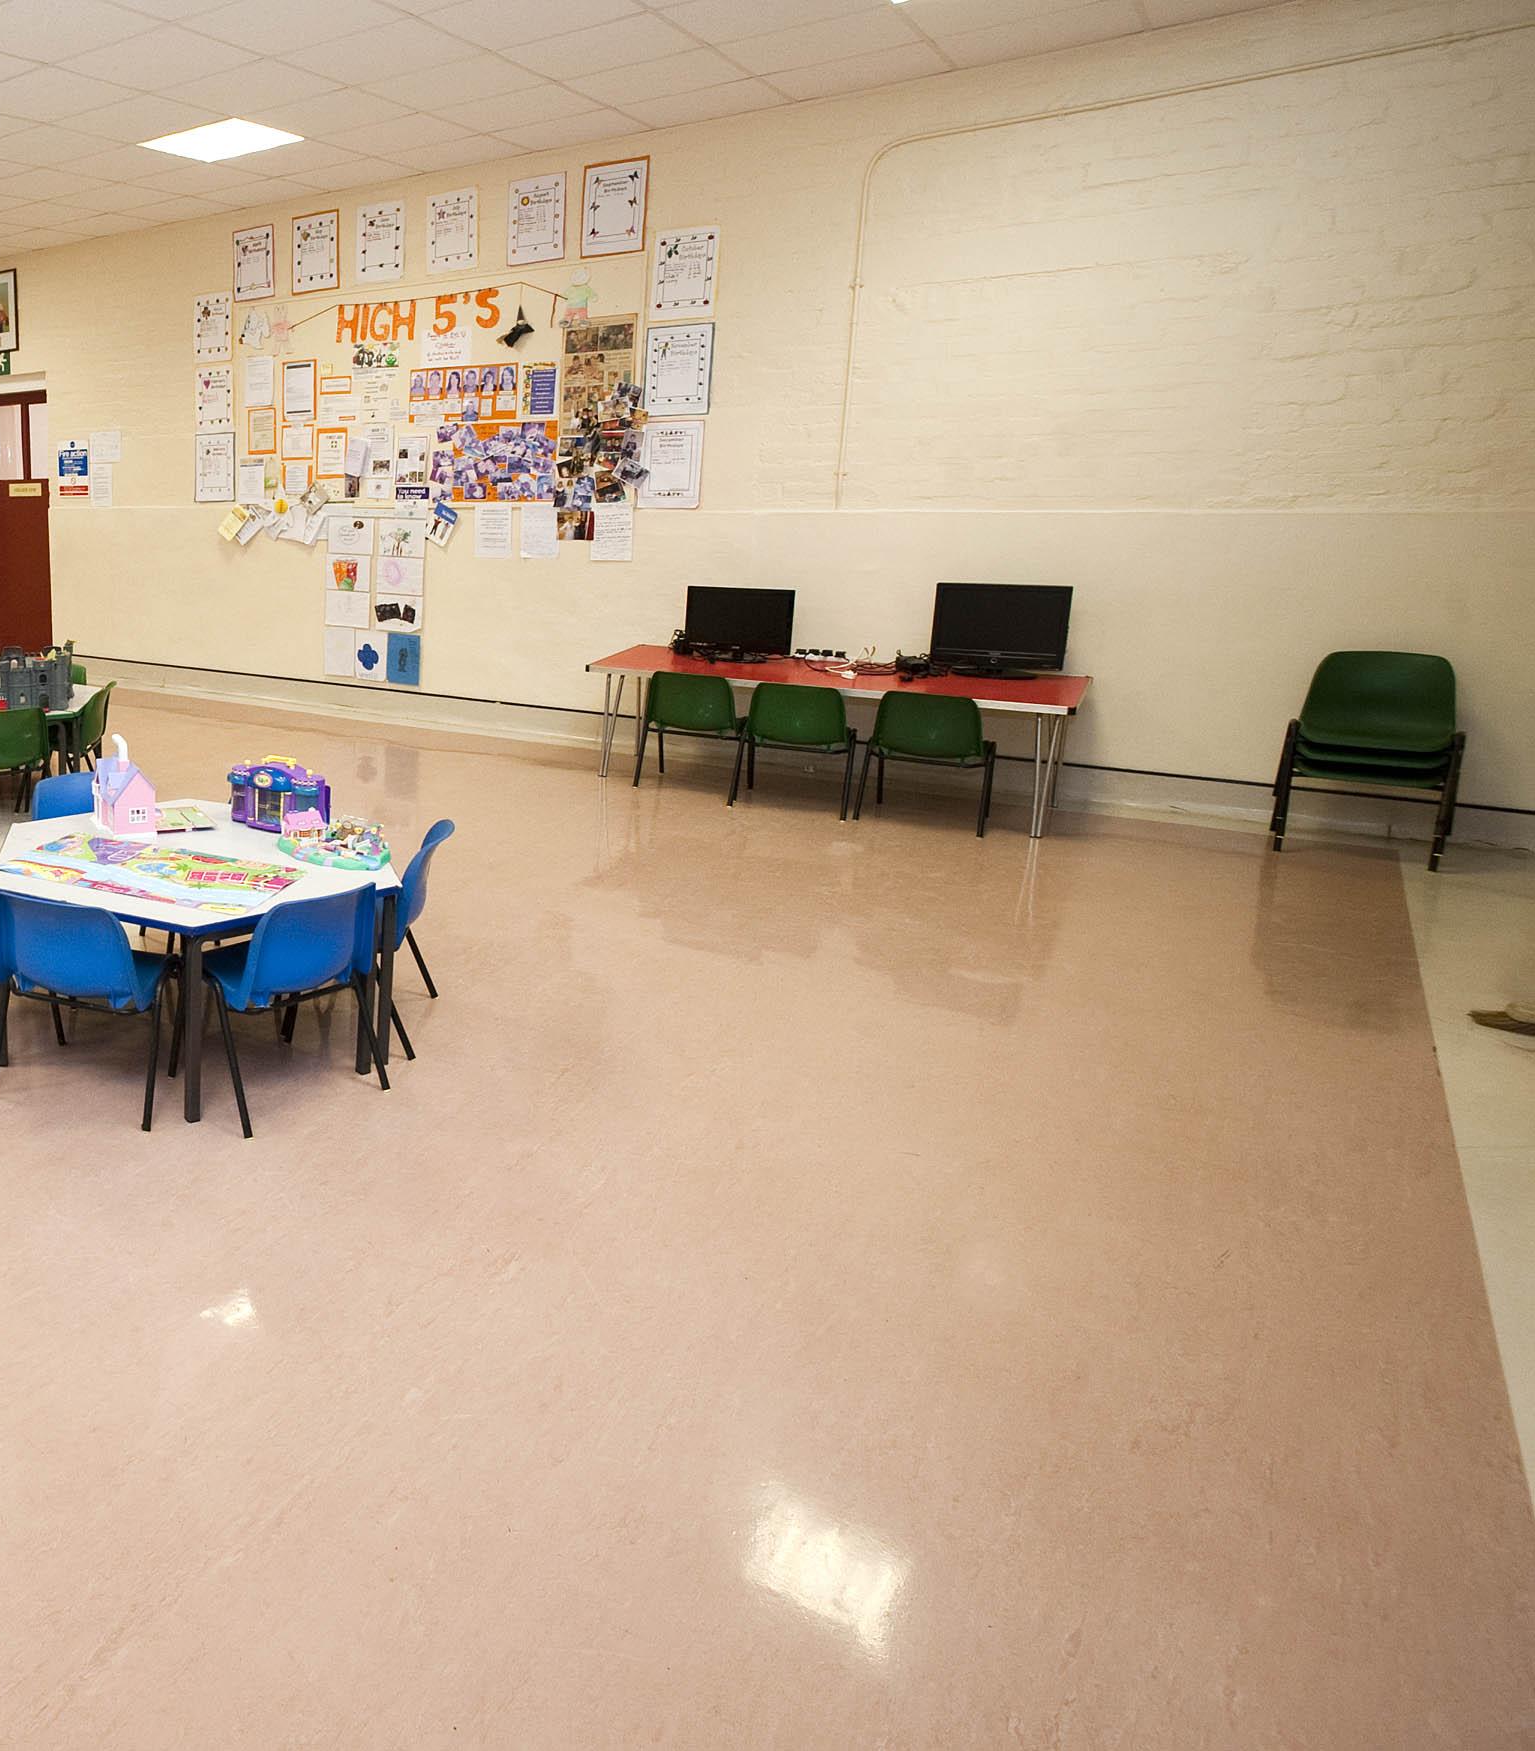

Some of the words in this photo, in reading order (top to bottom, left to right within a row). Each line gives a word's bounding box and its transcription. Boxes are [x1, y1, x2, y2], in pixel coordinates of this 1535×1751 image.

[336, 299, 416, 343] HIGH
[433, 288, 500, 335] 5'S
[397, 487, 409, 496] You
[410, 487, 426, 495] need
